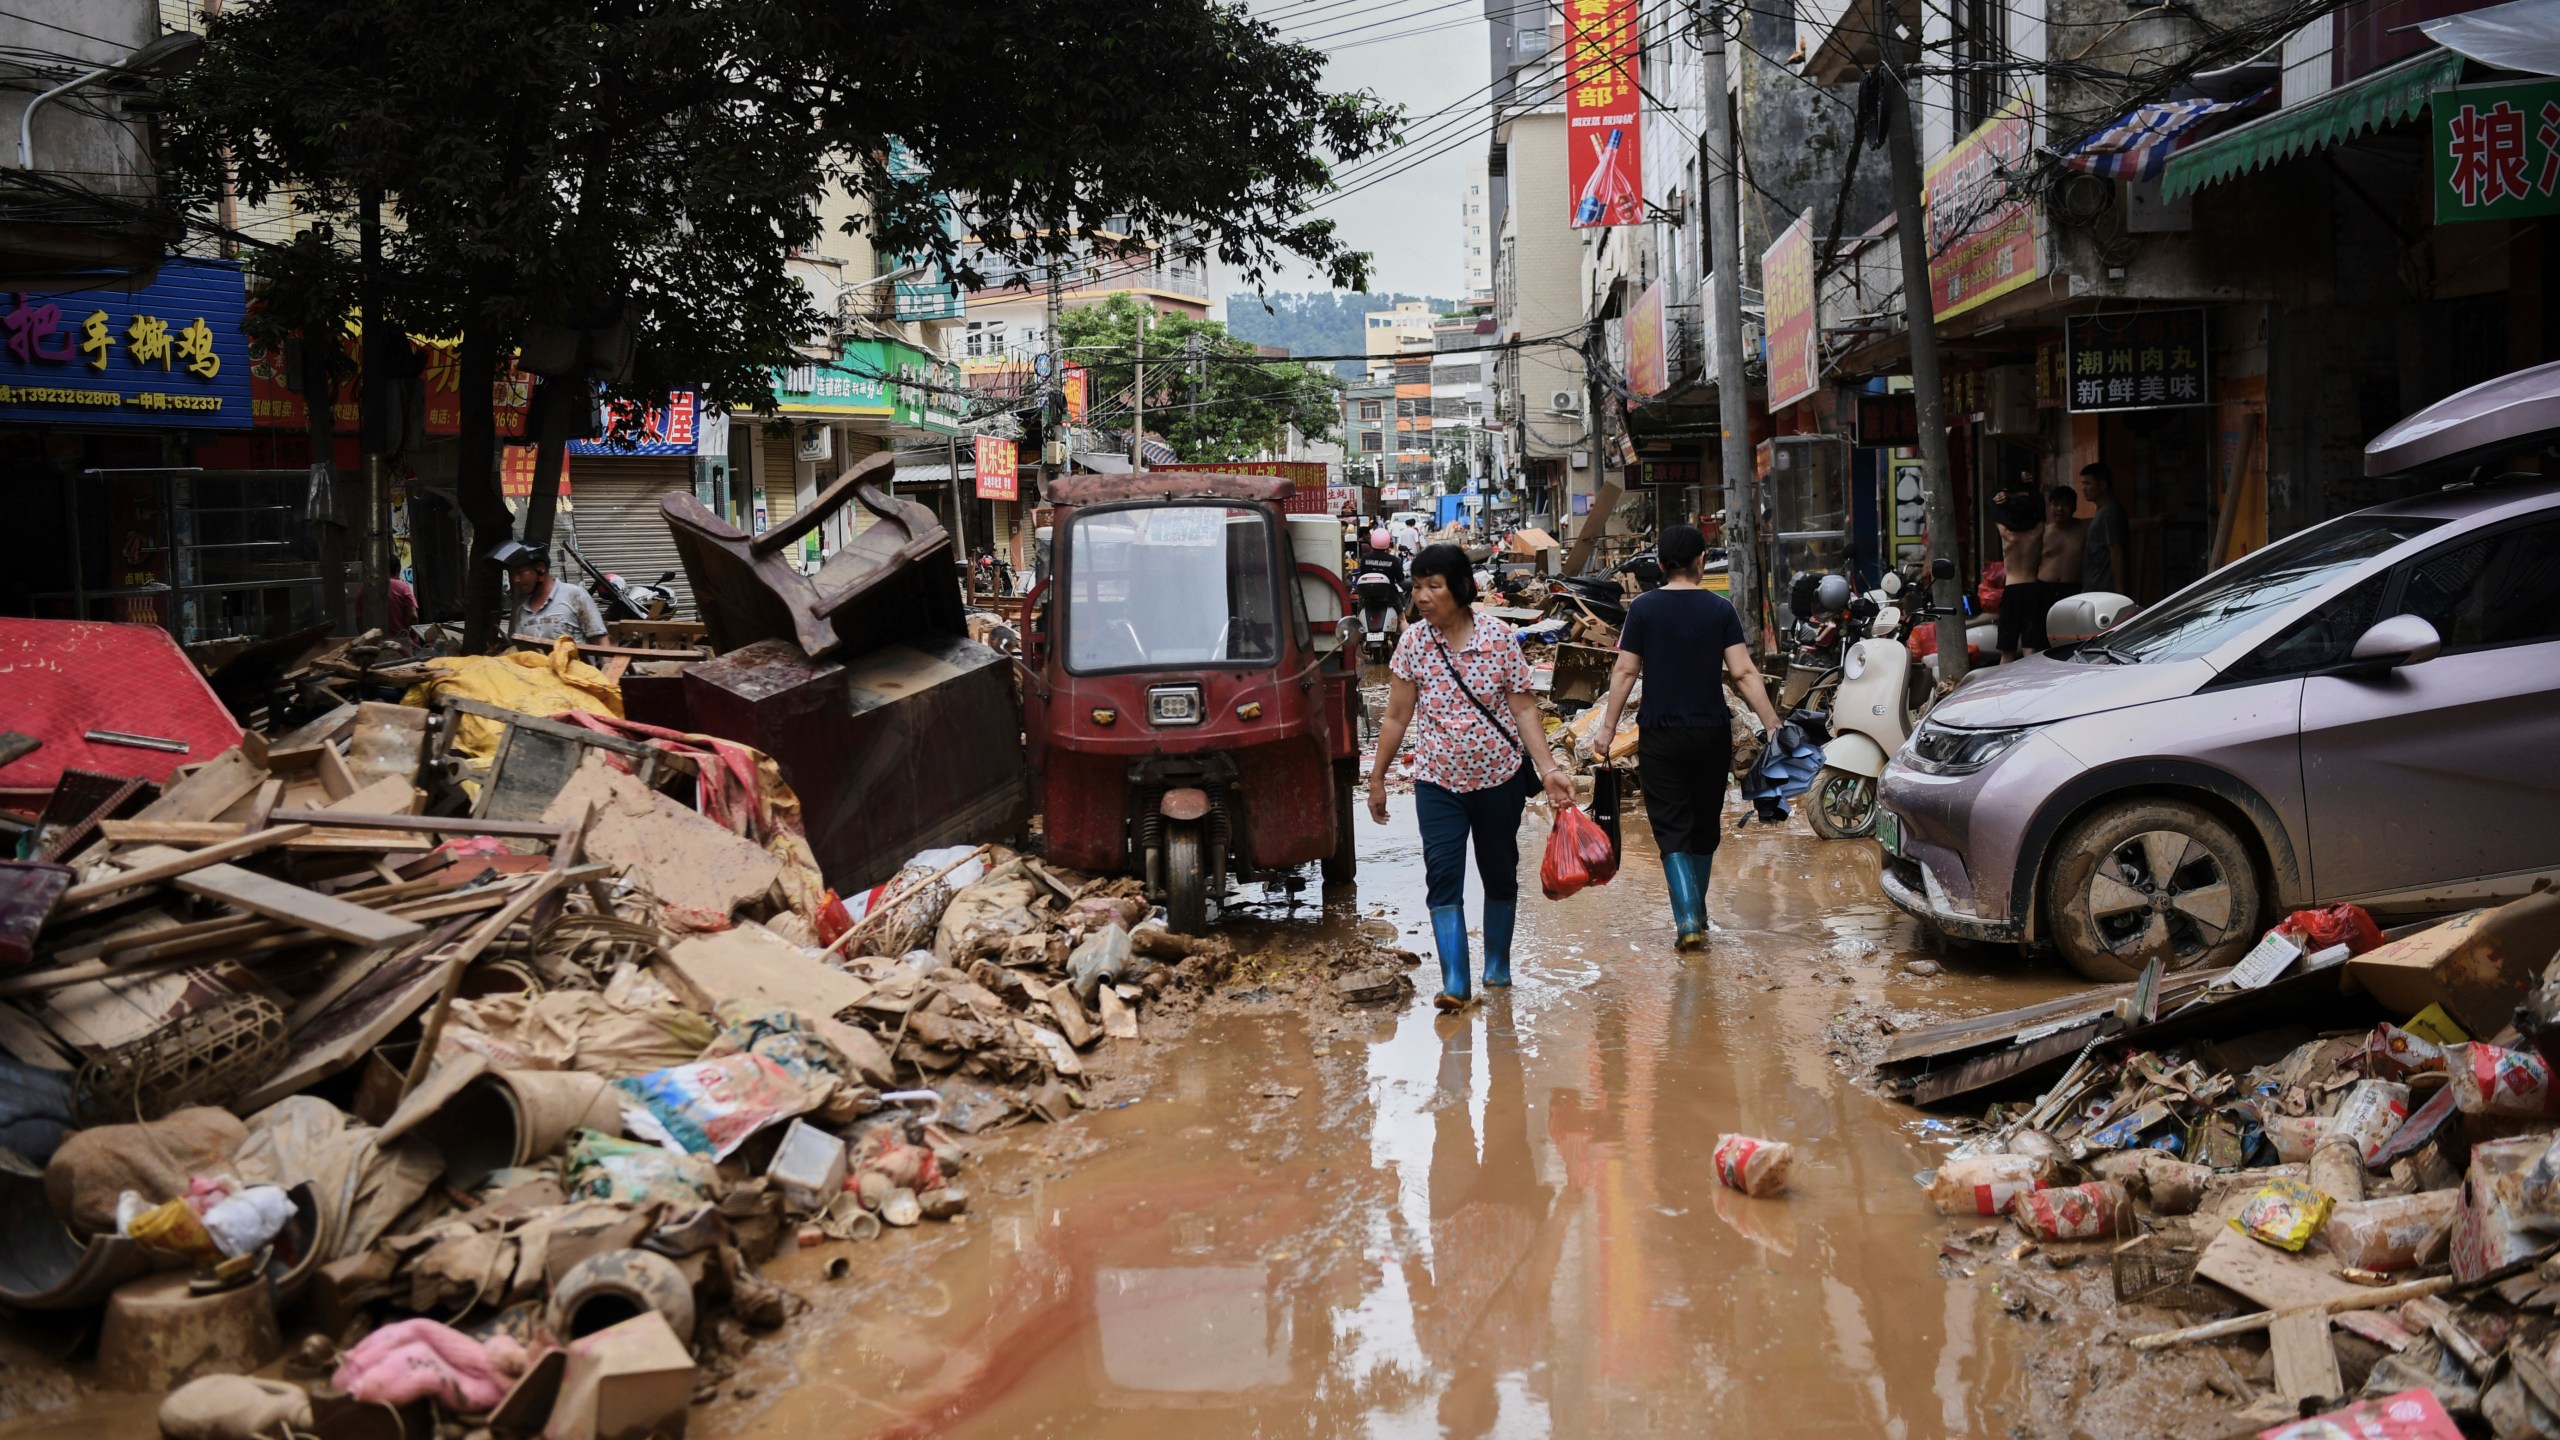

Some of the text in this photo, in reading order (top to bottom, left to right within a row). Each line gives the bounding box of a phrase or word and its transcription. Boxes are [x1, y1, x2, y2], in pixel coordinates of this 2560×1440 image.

[2077, 345, 2198, 375] 潮州肉丸
[2077, 374, 2198, 404] 新鲜美味
[979, 438, 1015, 477] 优乐生鲜
